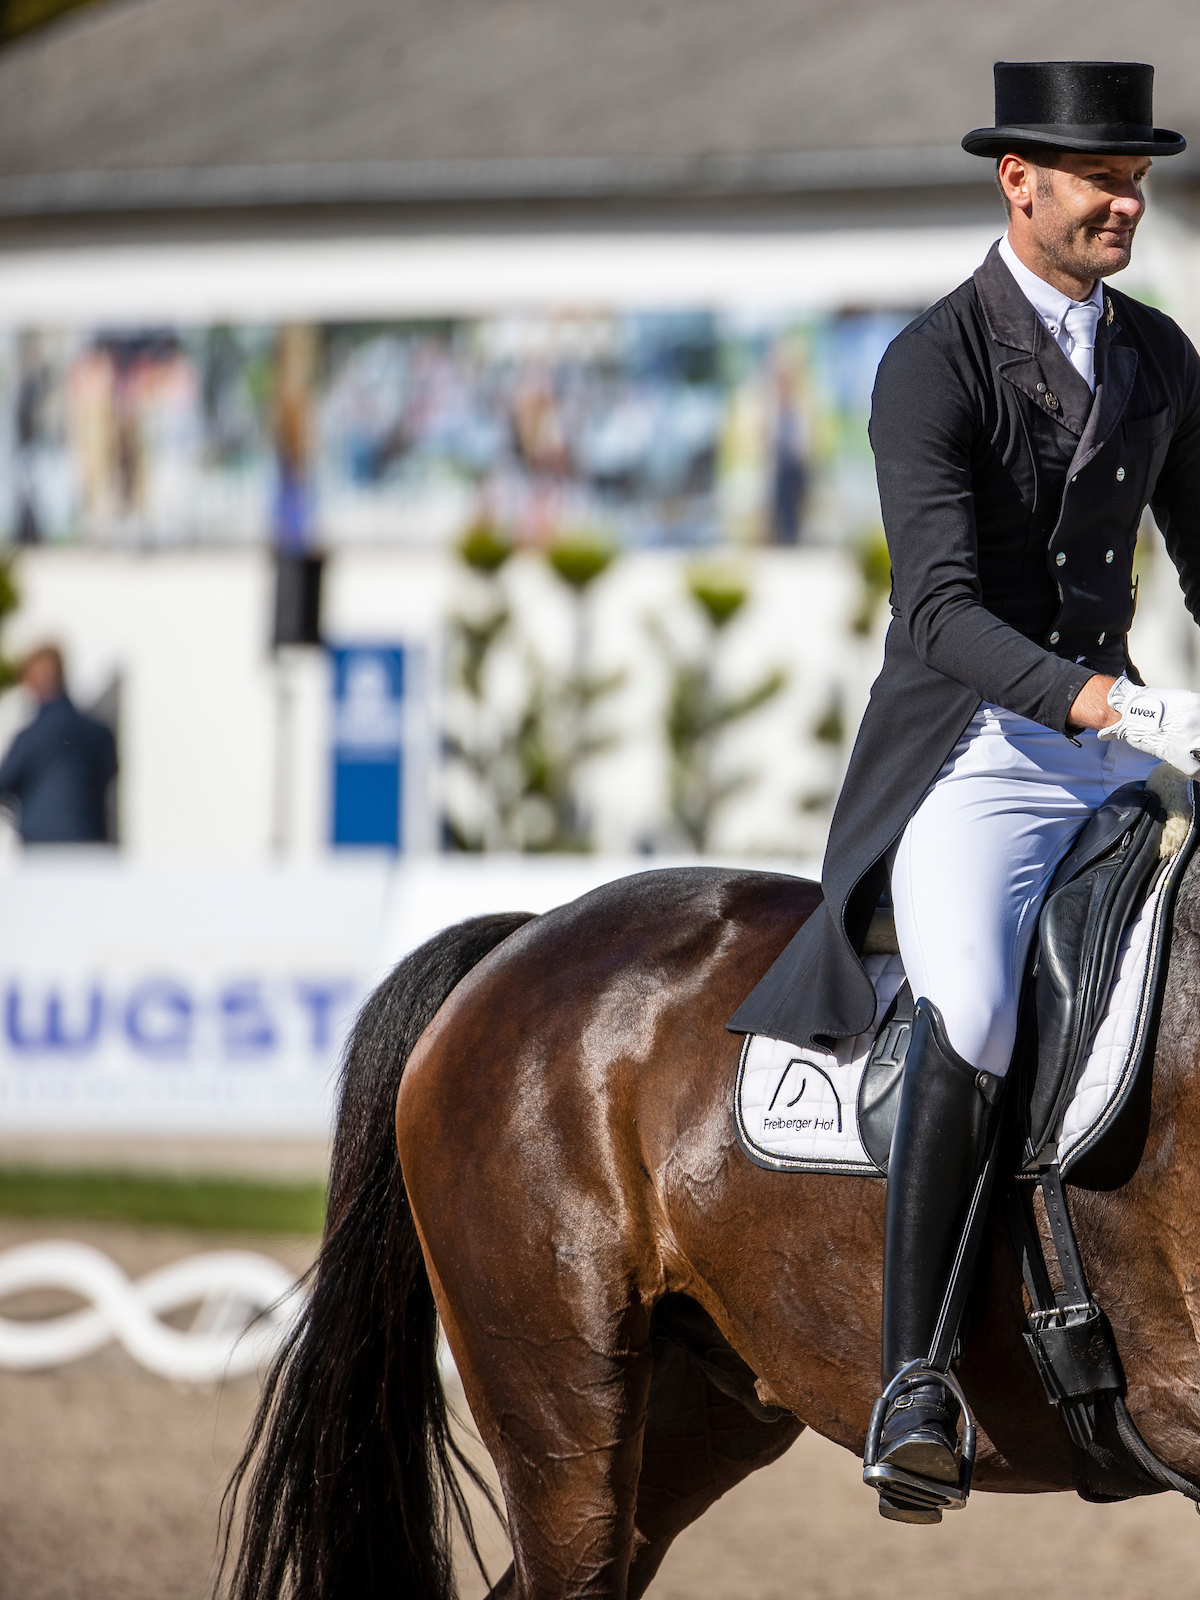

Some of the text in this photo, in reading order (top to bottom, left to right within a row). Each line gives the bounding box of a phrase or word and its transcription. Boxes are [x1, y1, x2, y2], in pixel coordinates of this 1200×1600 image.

[1130, 706, 1156, 718] uvex
[763, 1117, 834, 1131] Freiberger Hof
